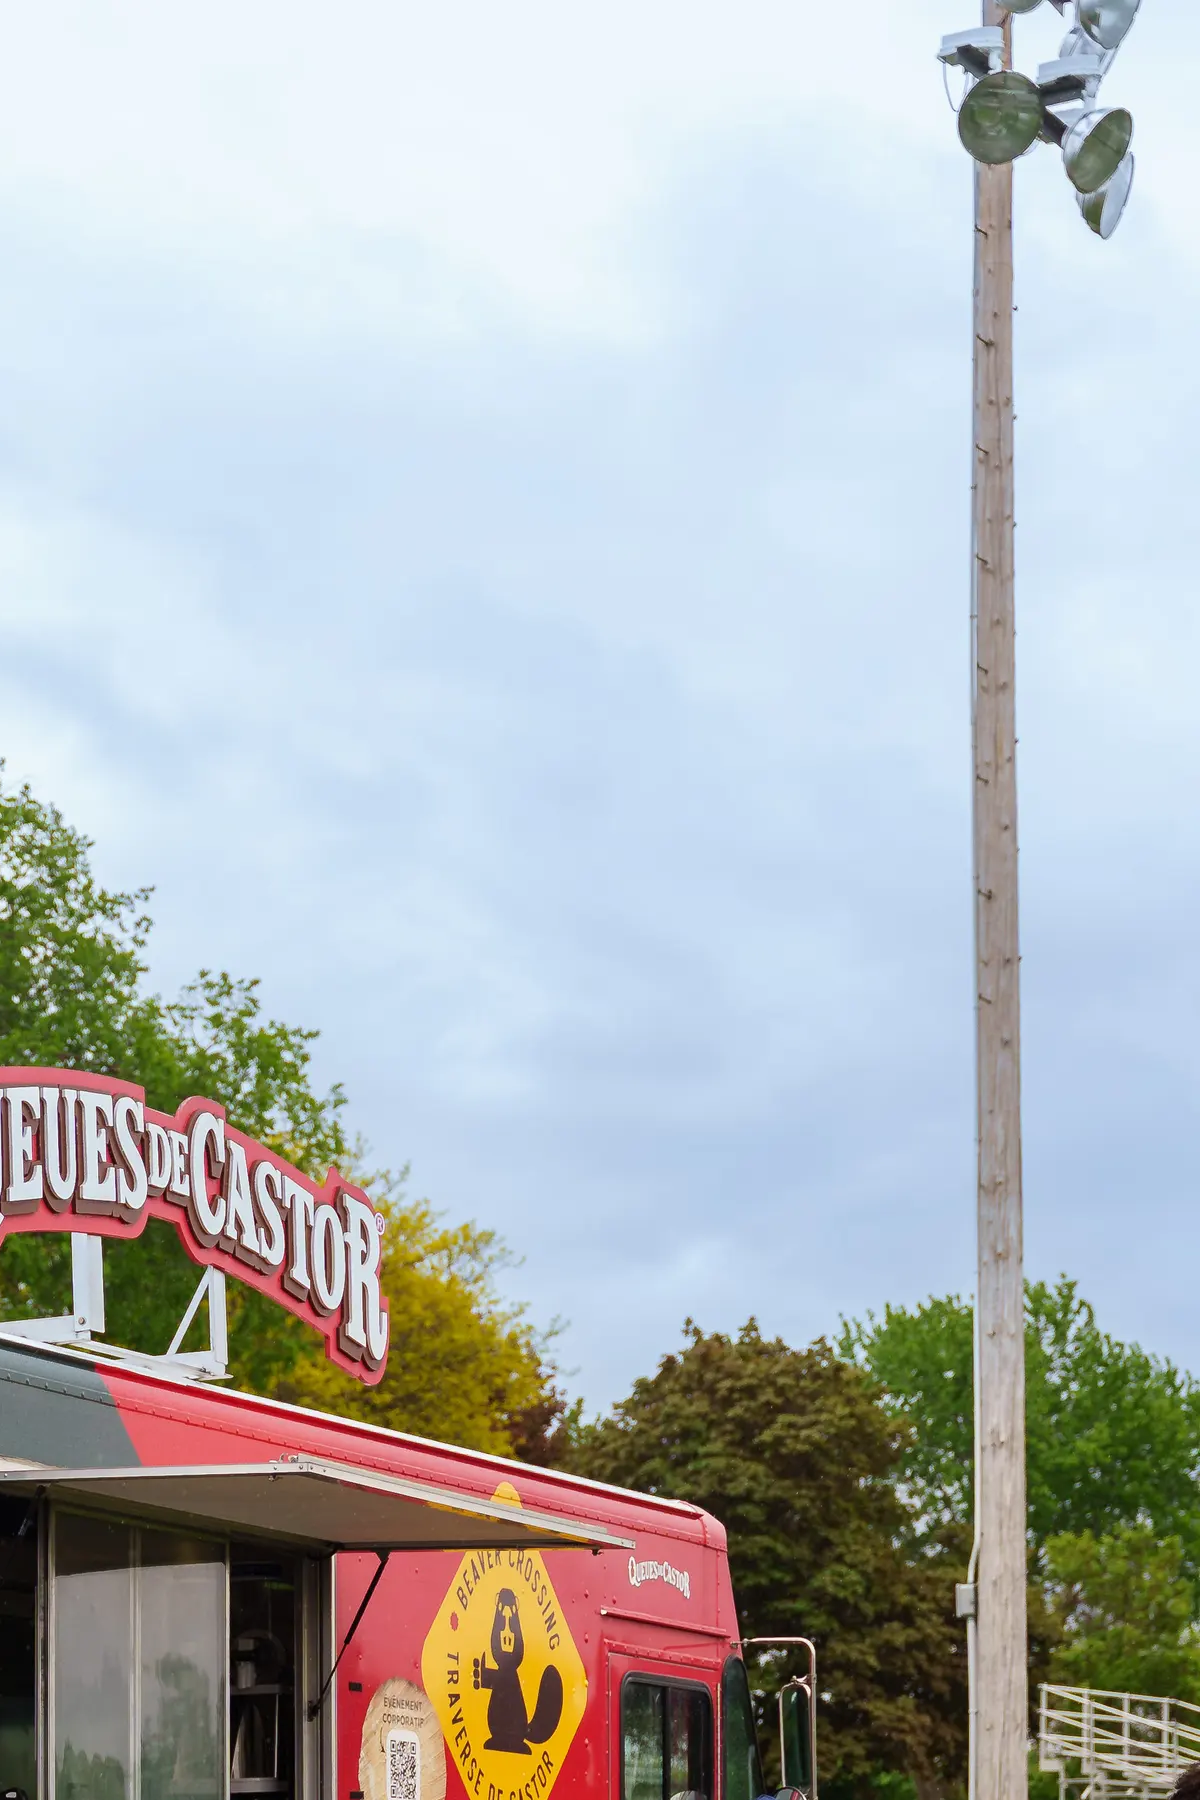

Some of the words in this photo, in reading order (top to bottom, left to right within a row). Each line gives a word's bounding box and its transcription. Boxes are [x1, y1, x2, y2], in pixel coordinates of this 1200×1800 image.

[147, 1121, 191, 1198] DE
[456, 1551, 501, 1611] BEAVER
[508, 1551, 560, 1651] CROSSING
[663, 1561, 690, 1599] CASTOR
[382, 1713, 424, 1728] CORPORATIF
[447, 1652, 484, 1795] TRAVERSE
